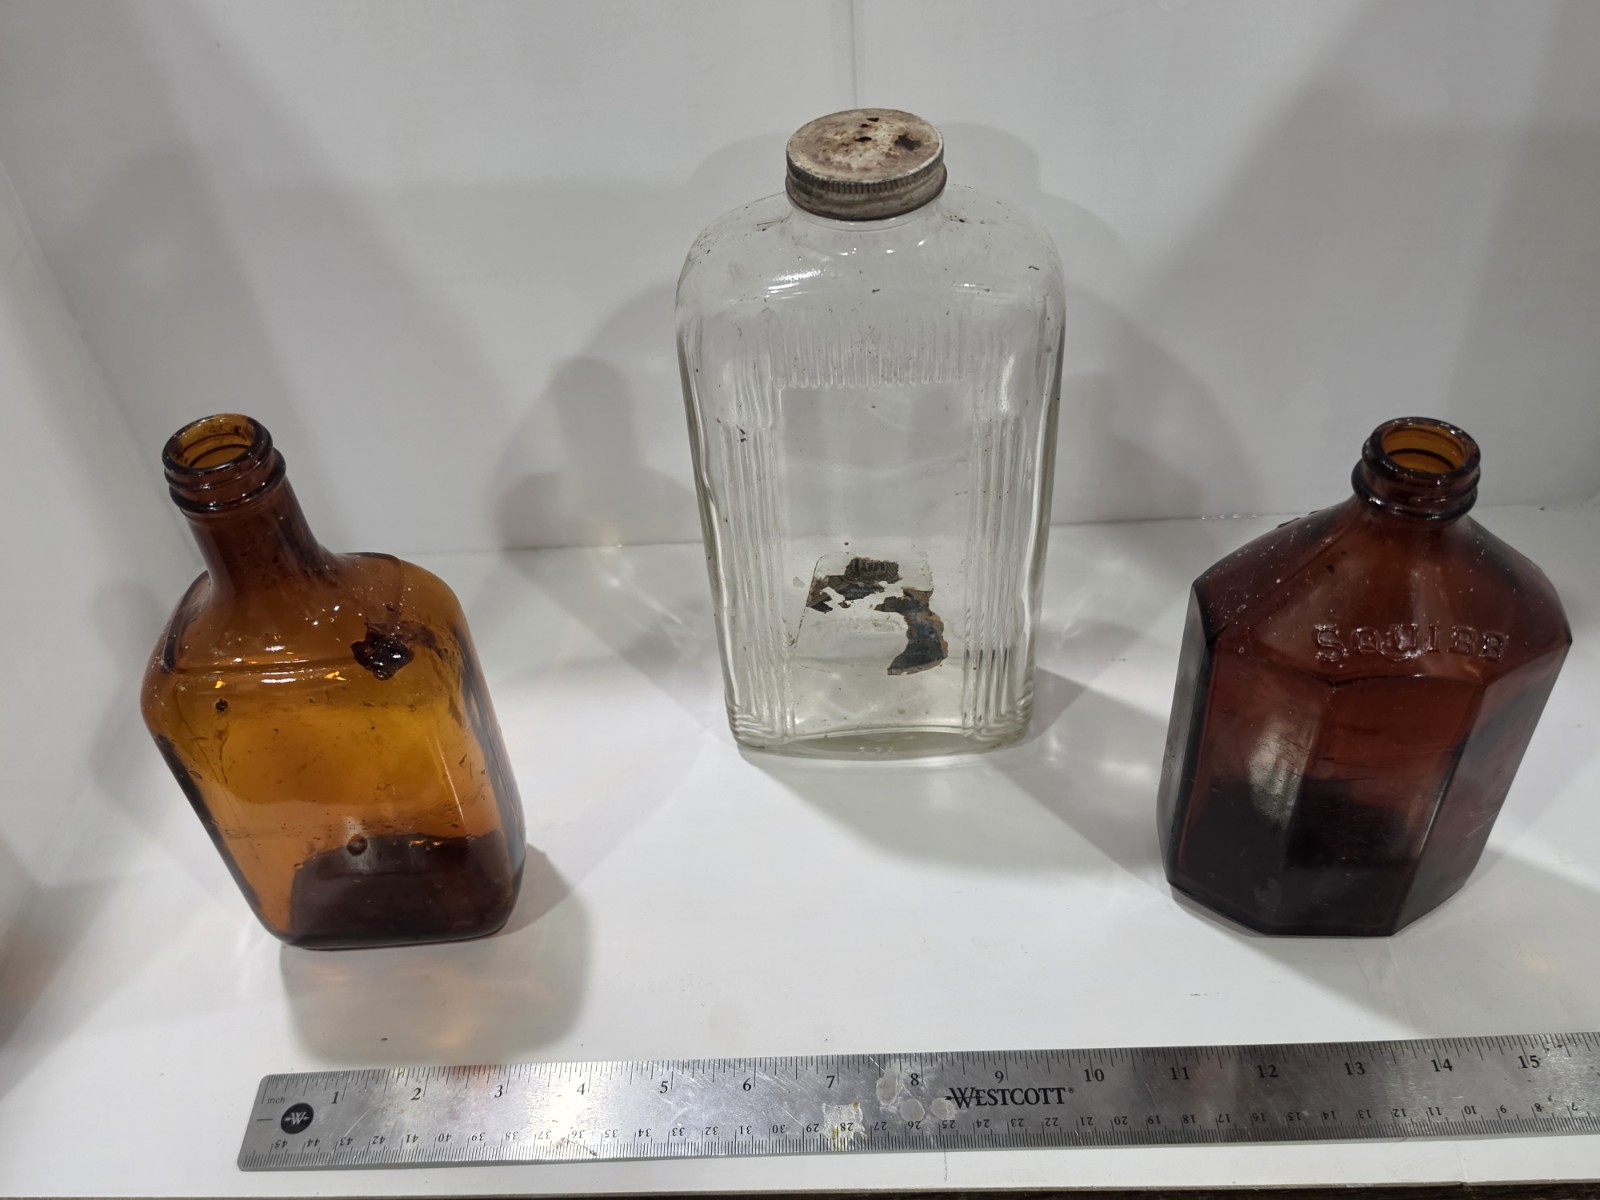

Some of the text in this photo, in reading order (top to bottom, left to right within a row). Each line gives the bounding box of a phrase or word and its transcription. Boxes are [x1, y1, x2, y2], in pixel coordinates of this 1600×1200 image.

[1311, 623, 1506, 662] SQUIBB
[331, 1054, 1540, 1104] 1 2 3 4 5 6 7 8 9 10 11 12 13 14 15
[274, 1102, 1578, 1148] 45 44 43 42 41 40 39 38 37 36 35 34 33 32 31 30 29 28 27 26 25 24 23 22 21 20 19 18 17 16 15 14 13 12 11 10 9 8 7
